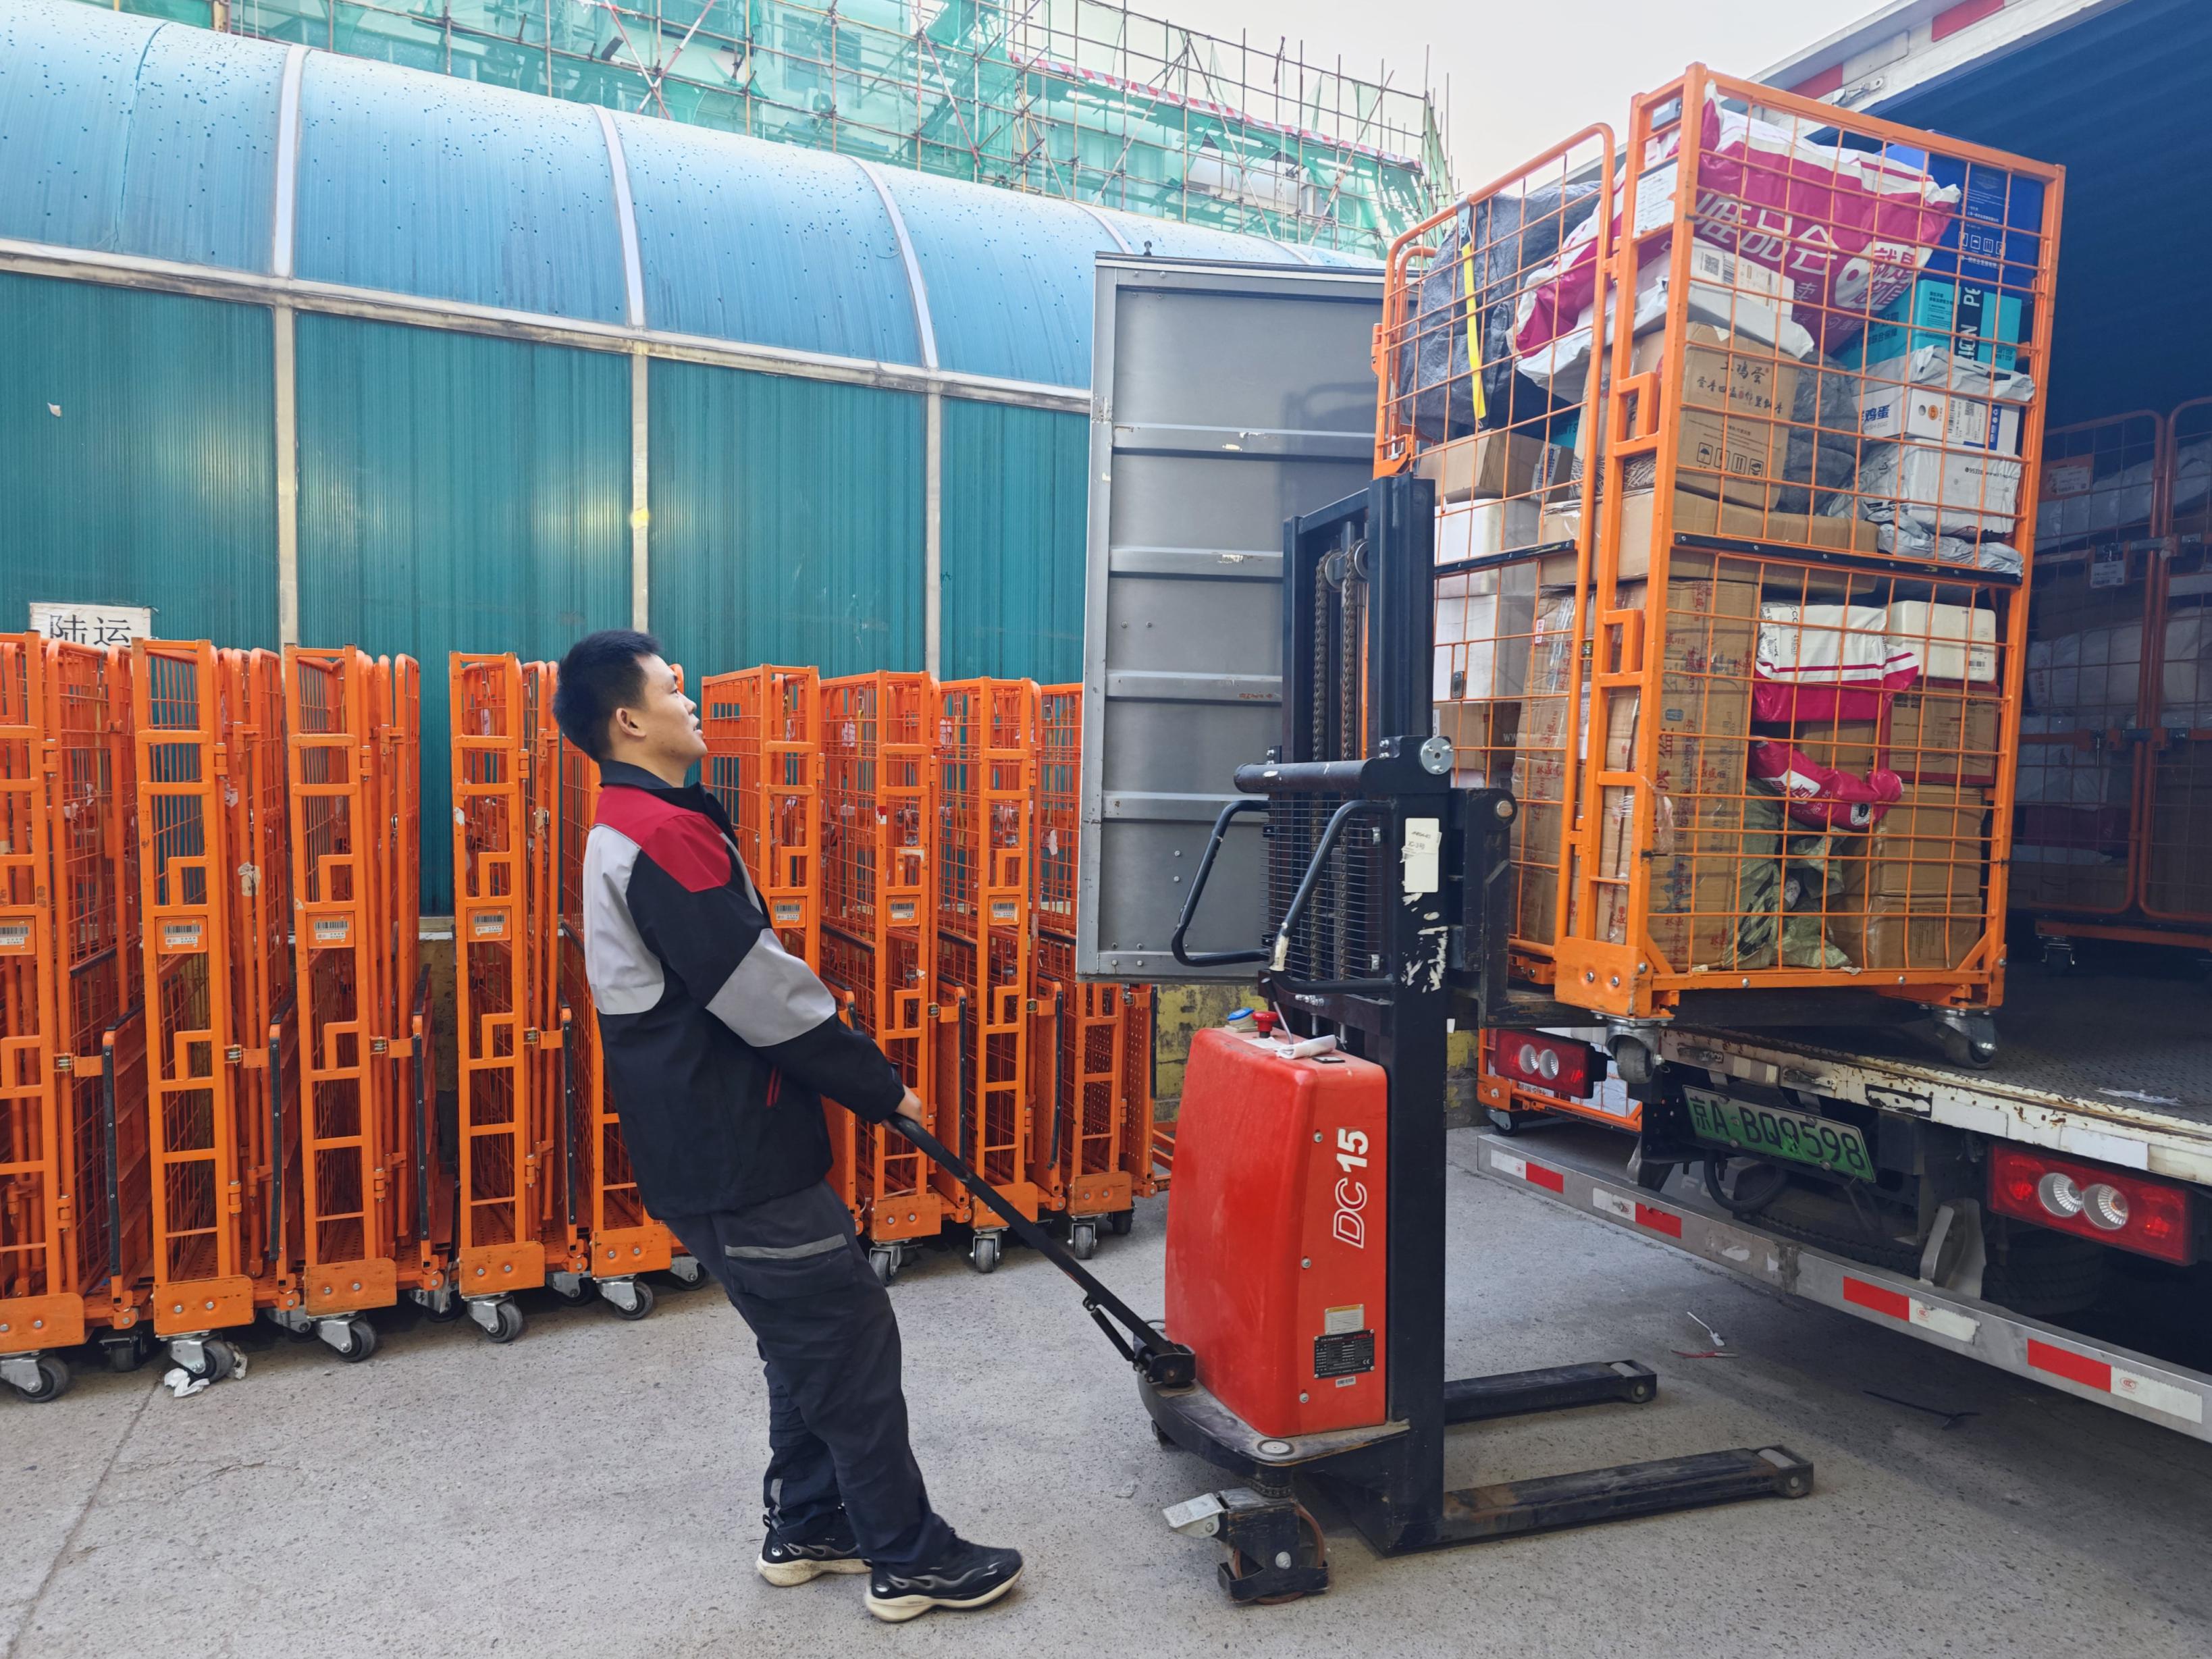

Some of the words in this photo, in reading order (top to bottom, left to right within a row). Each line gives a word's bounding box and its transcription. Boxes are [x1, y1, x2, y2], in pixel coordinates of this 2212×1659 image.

[49, 614, 132, 648] 陆运
[1336, 1128, 1369, 1172] 15
[1333, 1178, 1367, 1248] DC
